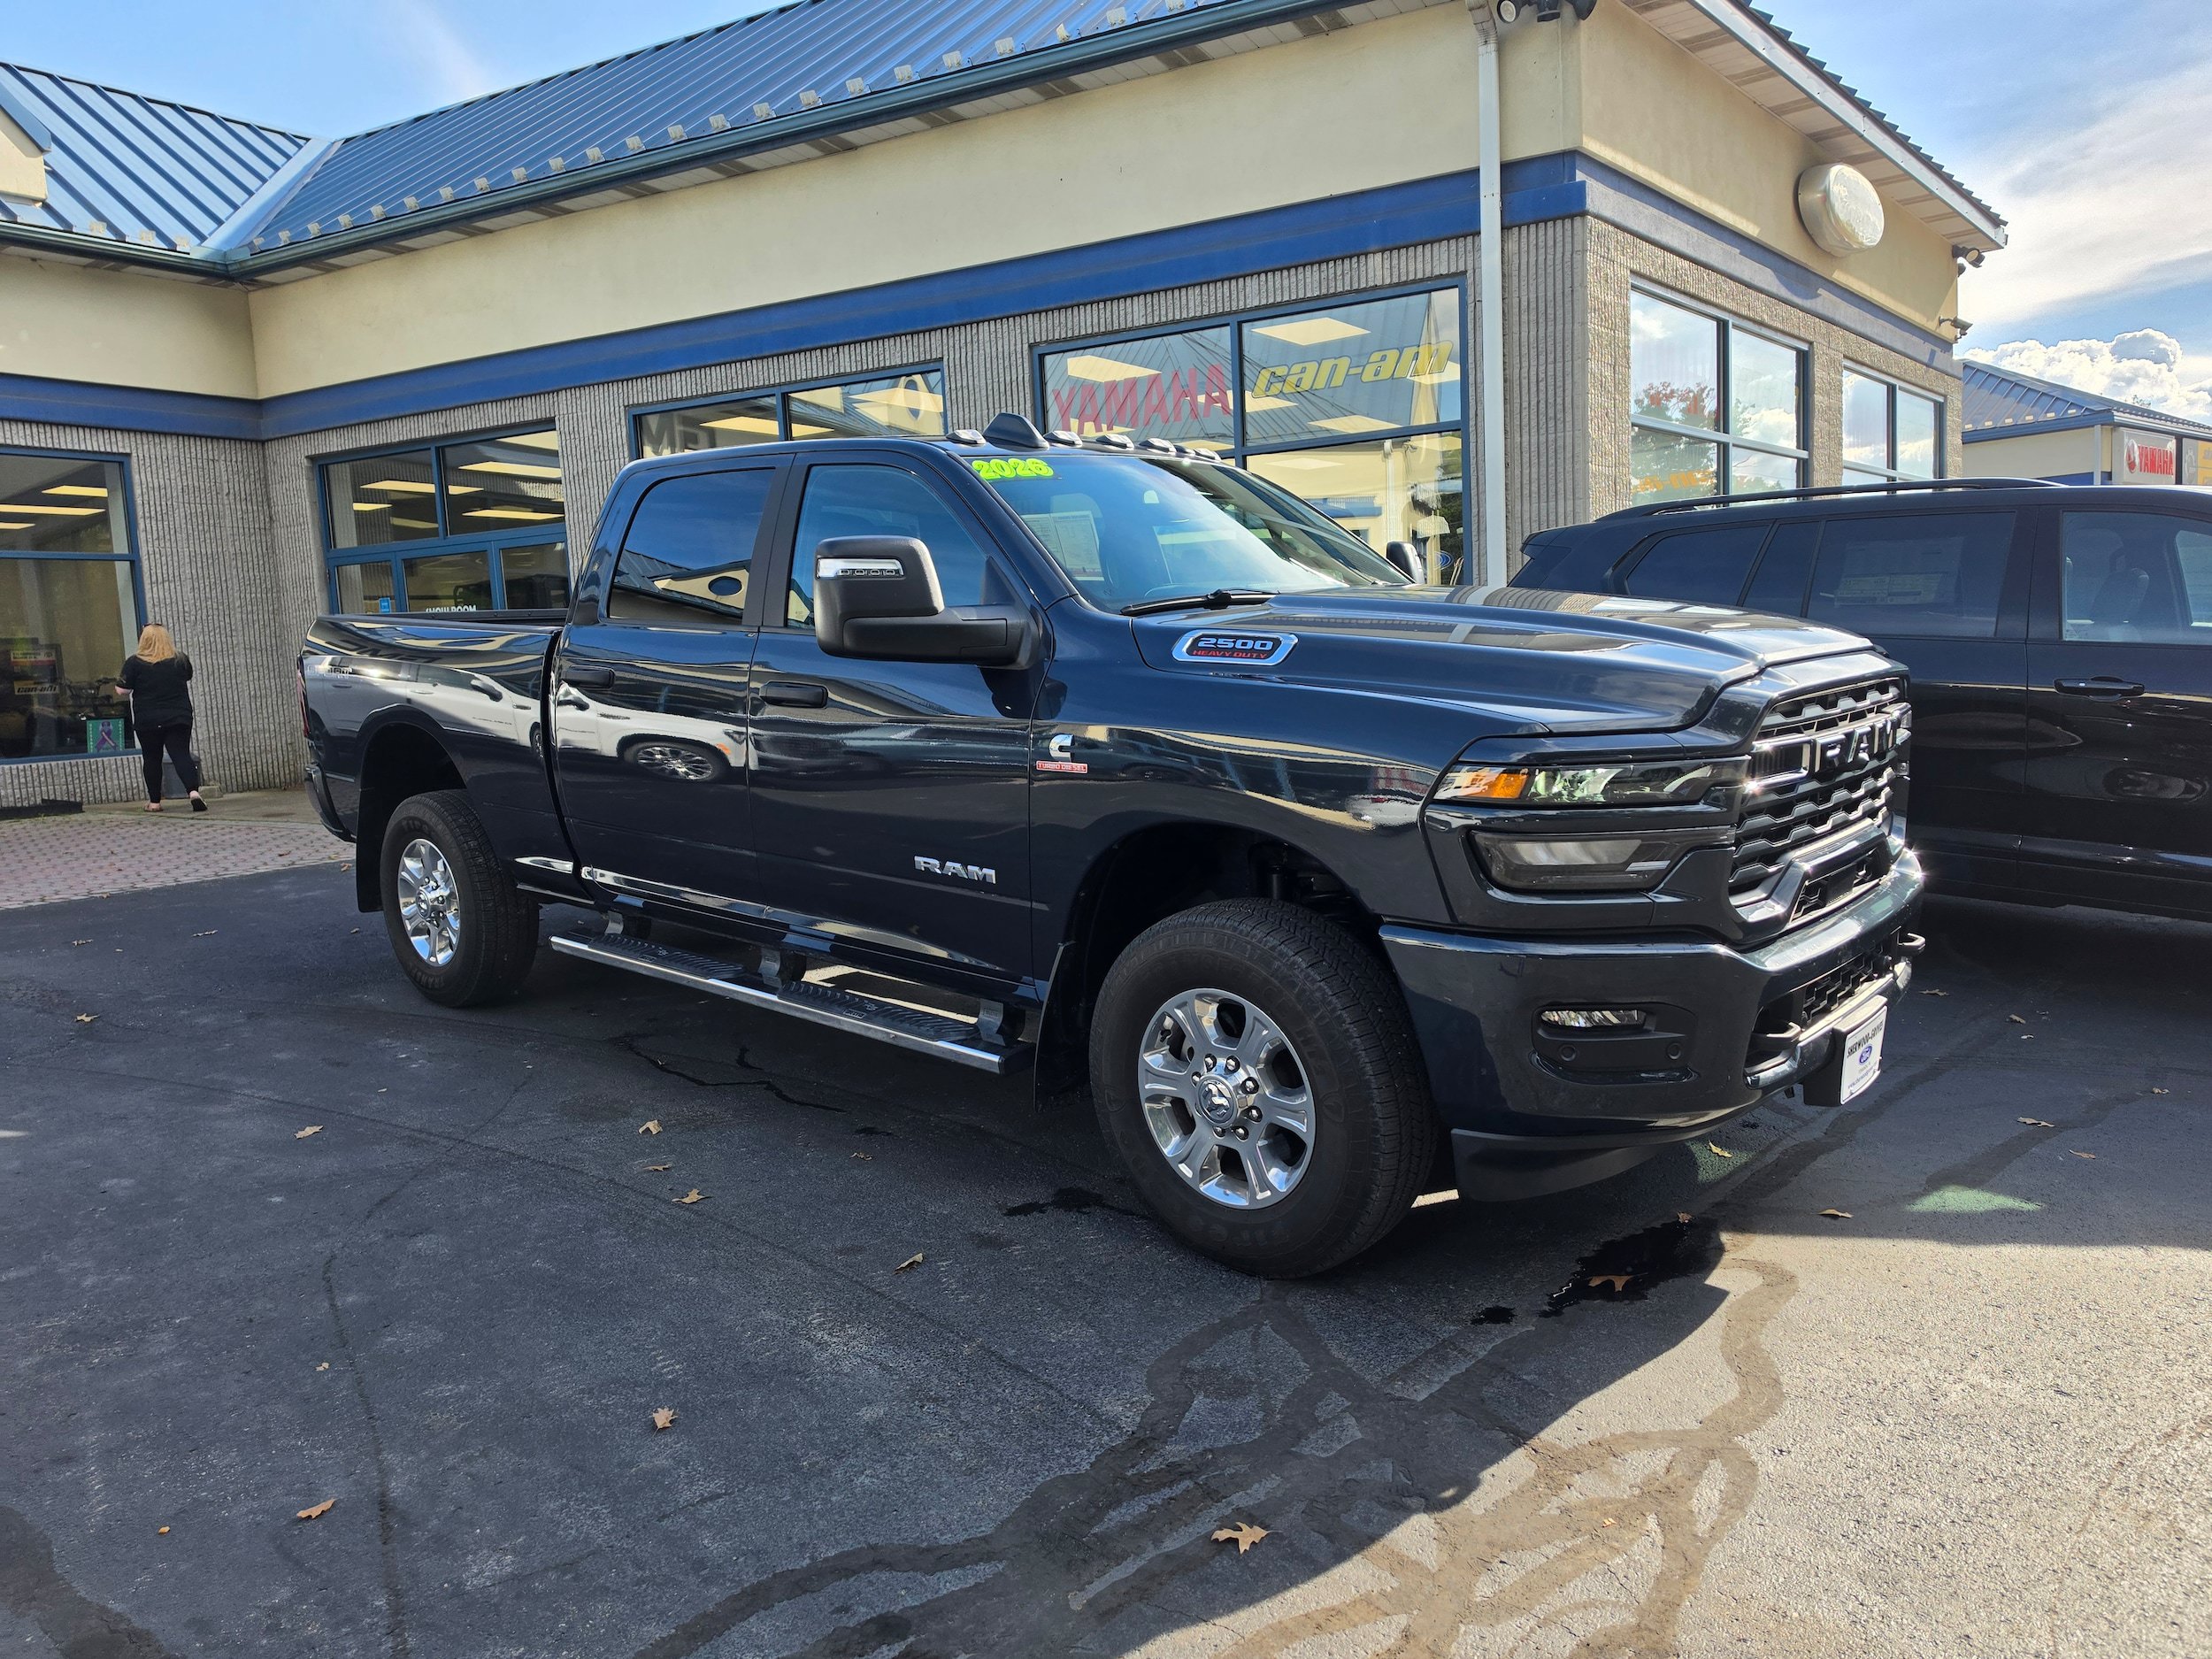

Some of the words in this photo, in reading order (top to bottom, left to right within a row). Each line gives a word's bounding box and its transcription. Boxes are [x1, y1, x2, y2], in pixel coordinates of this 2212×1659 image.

[1251, 340, 1454, 398] can-am
[1053, 364, 1232, 435] YAMAHA
[972, 458, 1054, 479] 2026
[2138, 444, 2175, 475] YAMAHA
[1197, 637, 1273, 650] 2500
[1815, 718, 1898, 774] RAM
[1062, 763, 1087, 772] DIESEL
[914, 856, 996, 885] RAM
